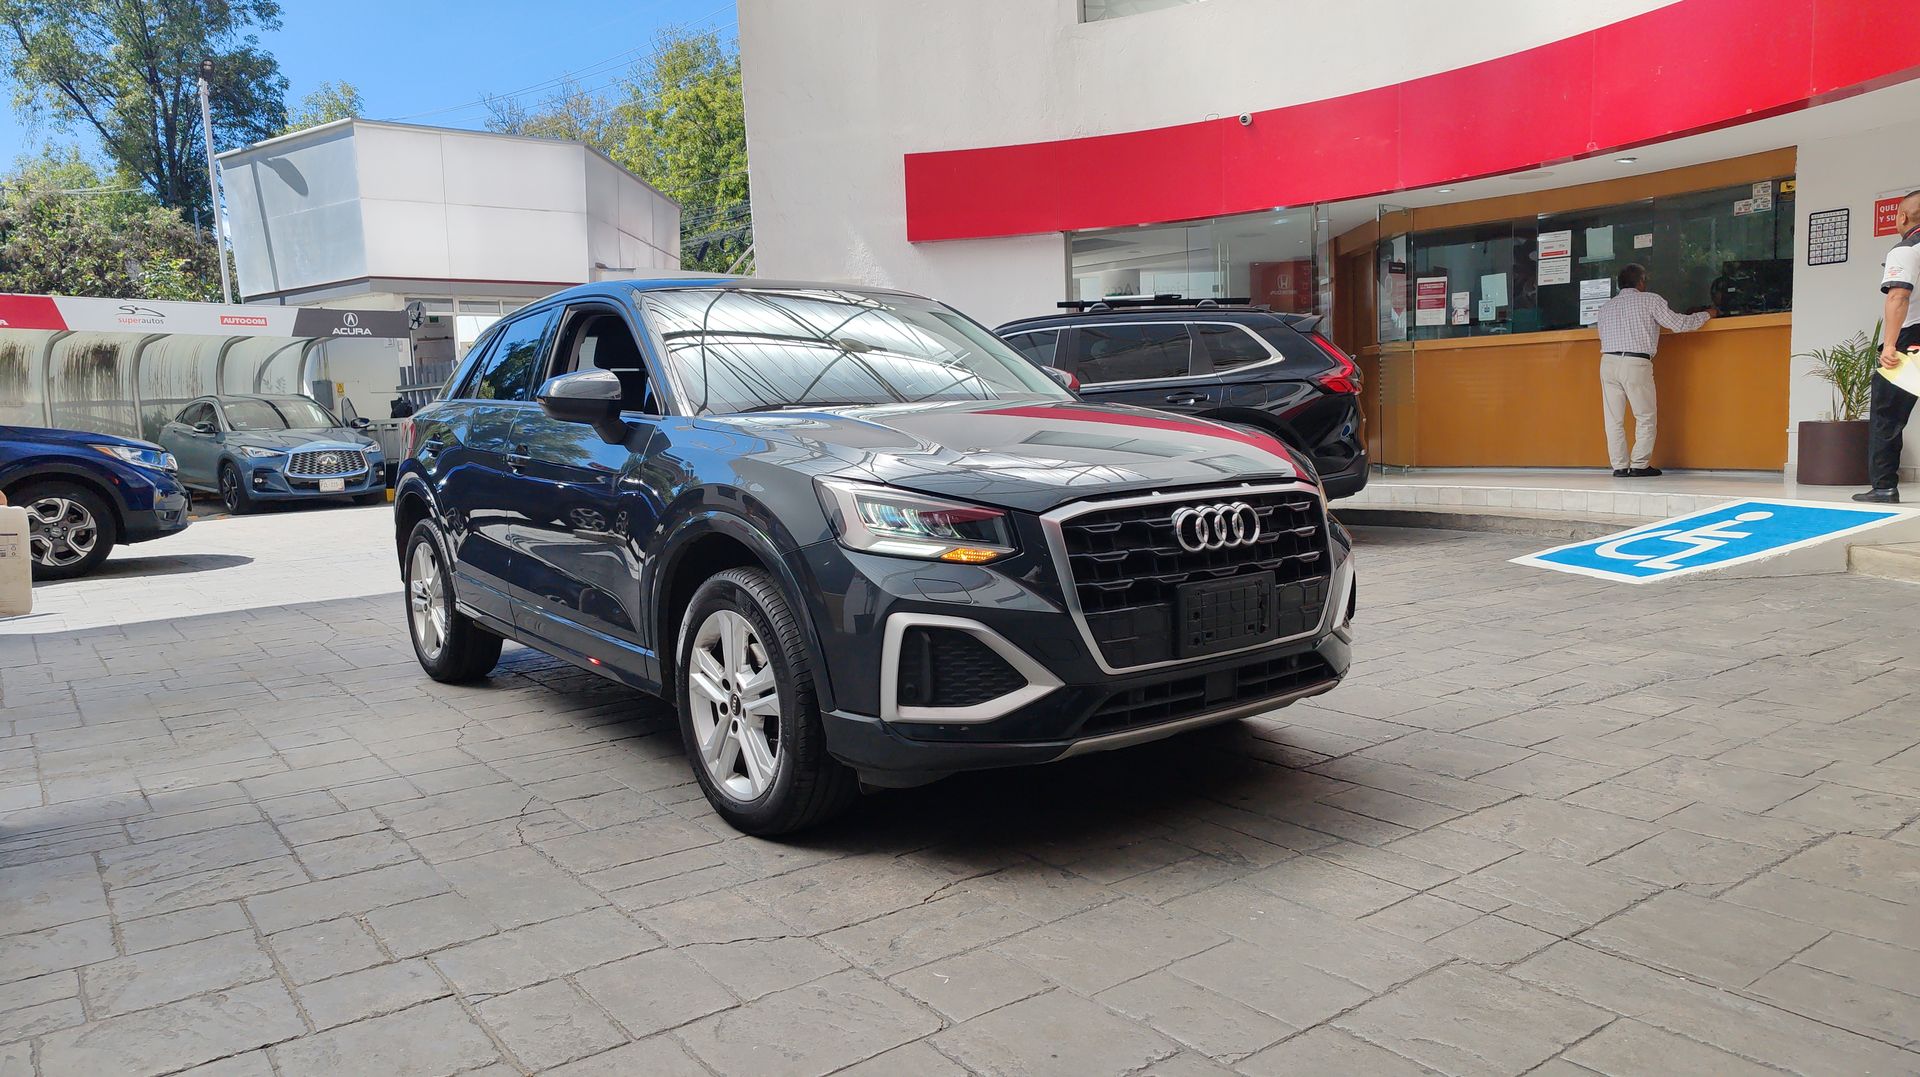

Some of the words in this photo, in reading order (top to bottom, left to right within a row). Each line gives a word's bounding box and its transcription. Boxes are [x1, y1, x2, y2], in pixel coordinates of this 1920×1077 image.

[1879, 204, 1898, 213] QUEJ
[117, 317, 165, 325] superautos
[222, 317, 267, 326] AUTOCOM
[331, 327, 373, 336] ACURA
